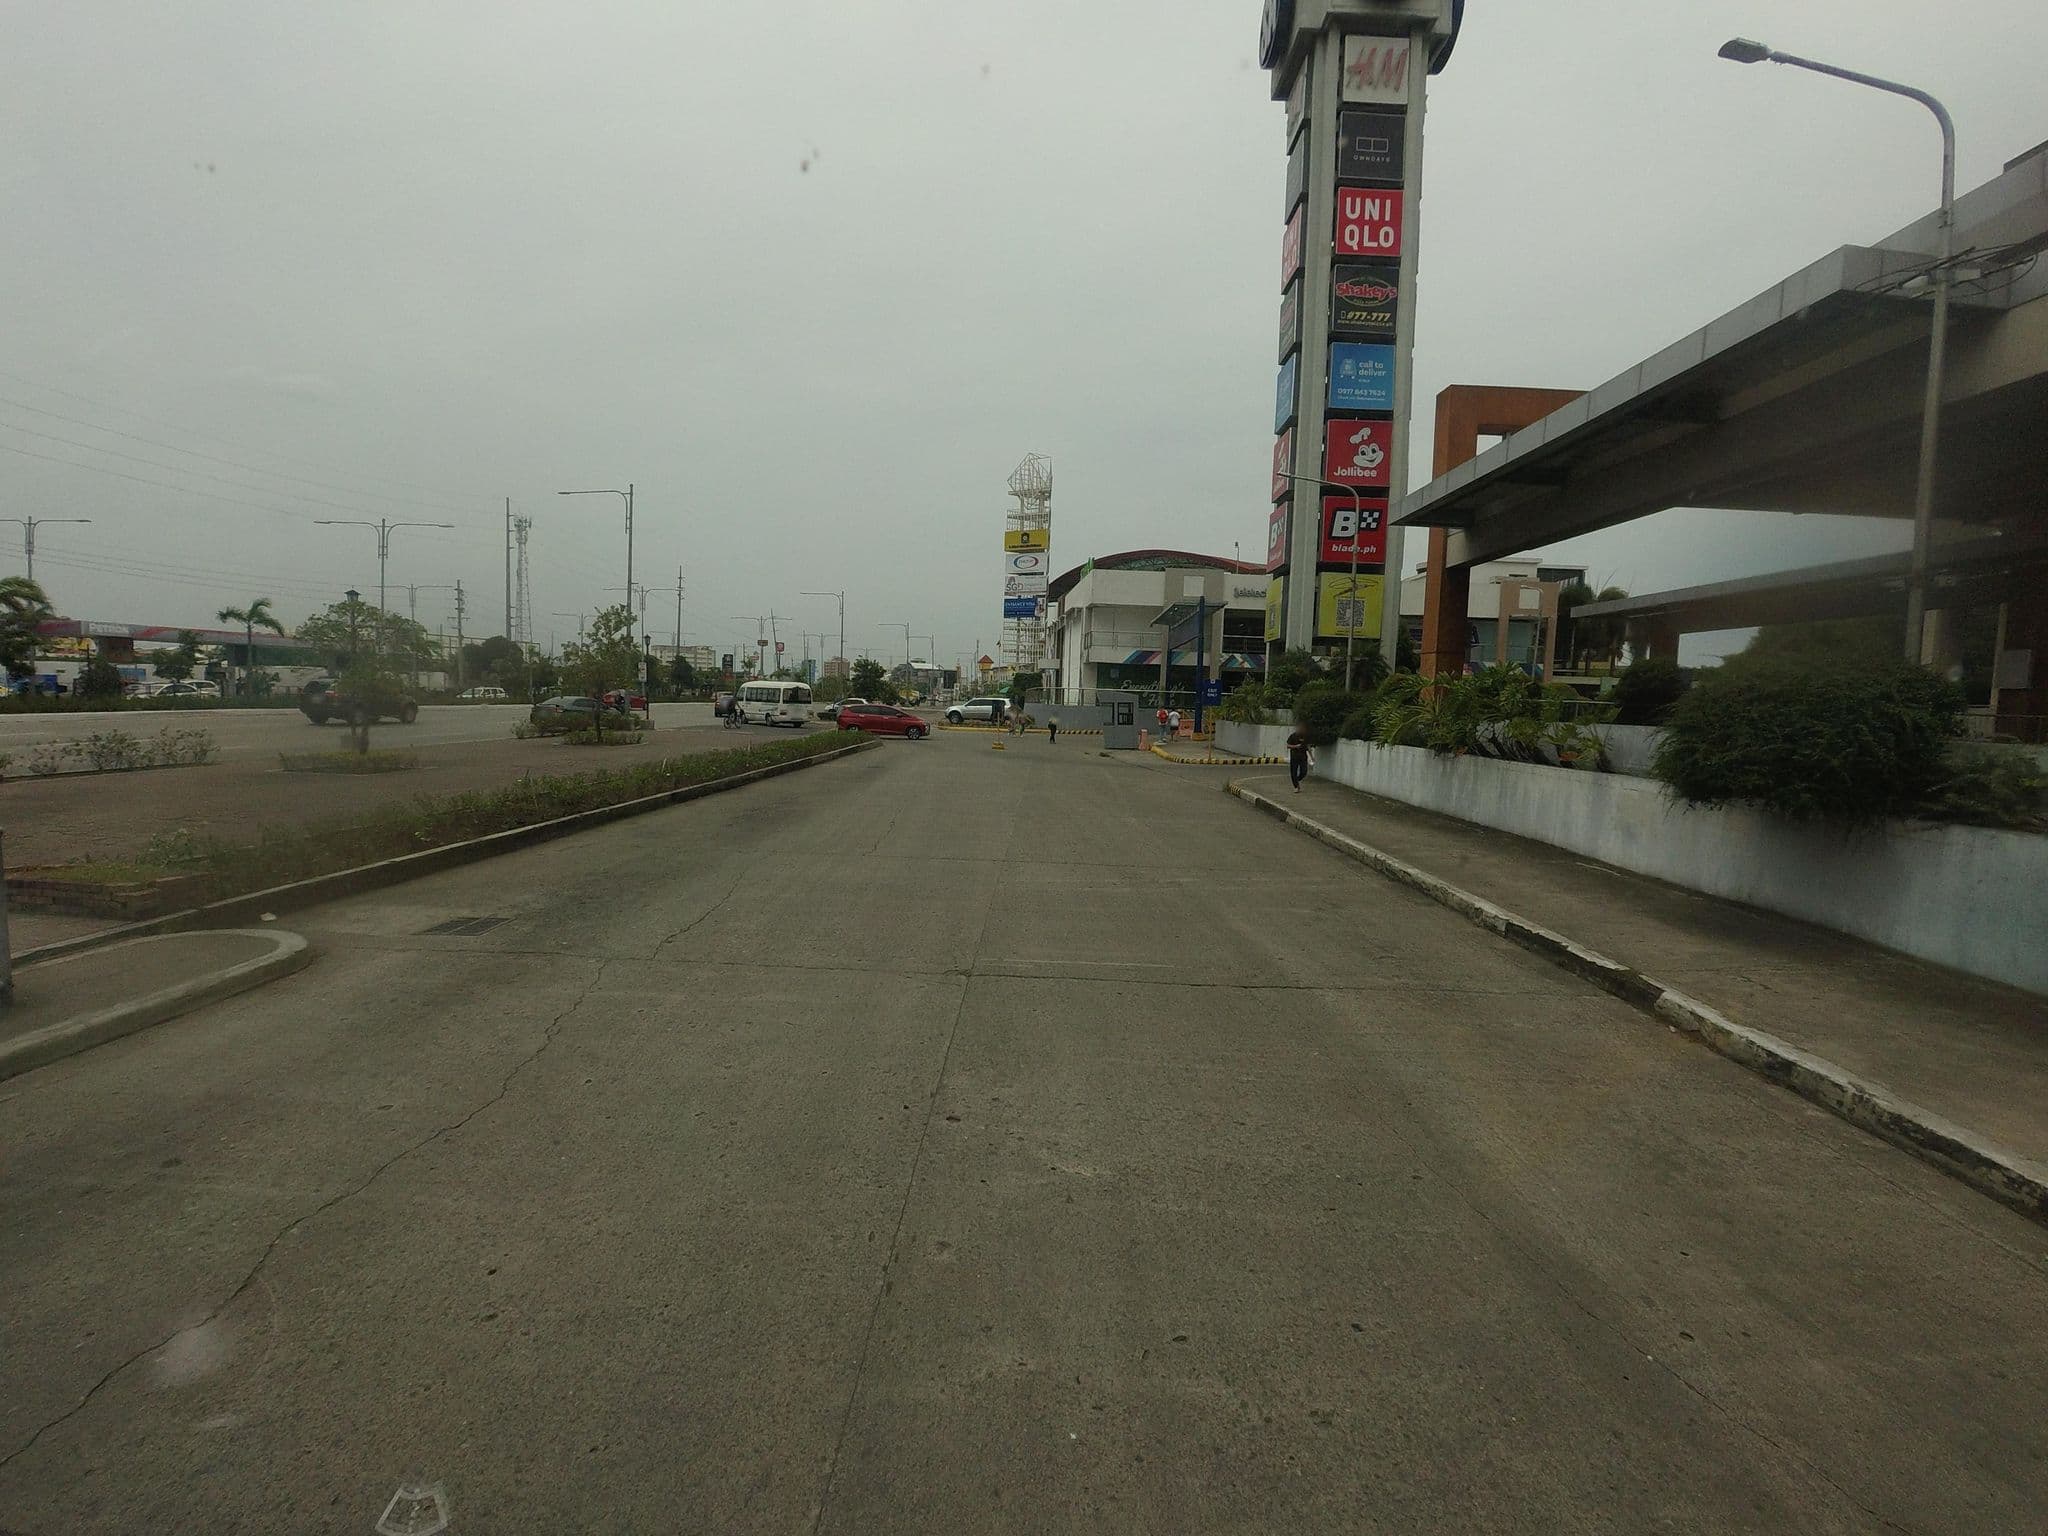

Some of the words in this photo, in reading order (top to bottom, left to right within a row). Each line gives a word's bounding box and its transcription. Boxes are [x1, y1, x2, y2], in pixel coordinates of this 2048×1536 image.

[1345, 197, 1392, 222] UNI
[1344, 225, 1395, 250] QLO
[1333, 466, 1377, 478] Jollibee
